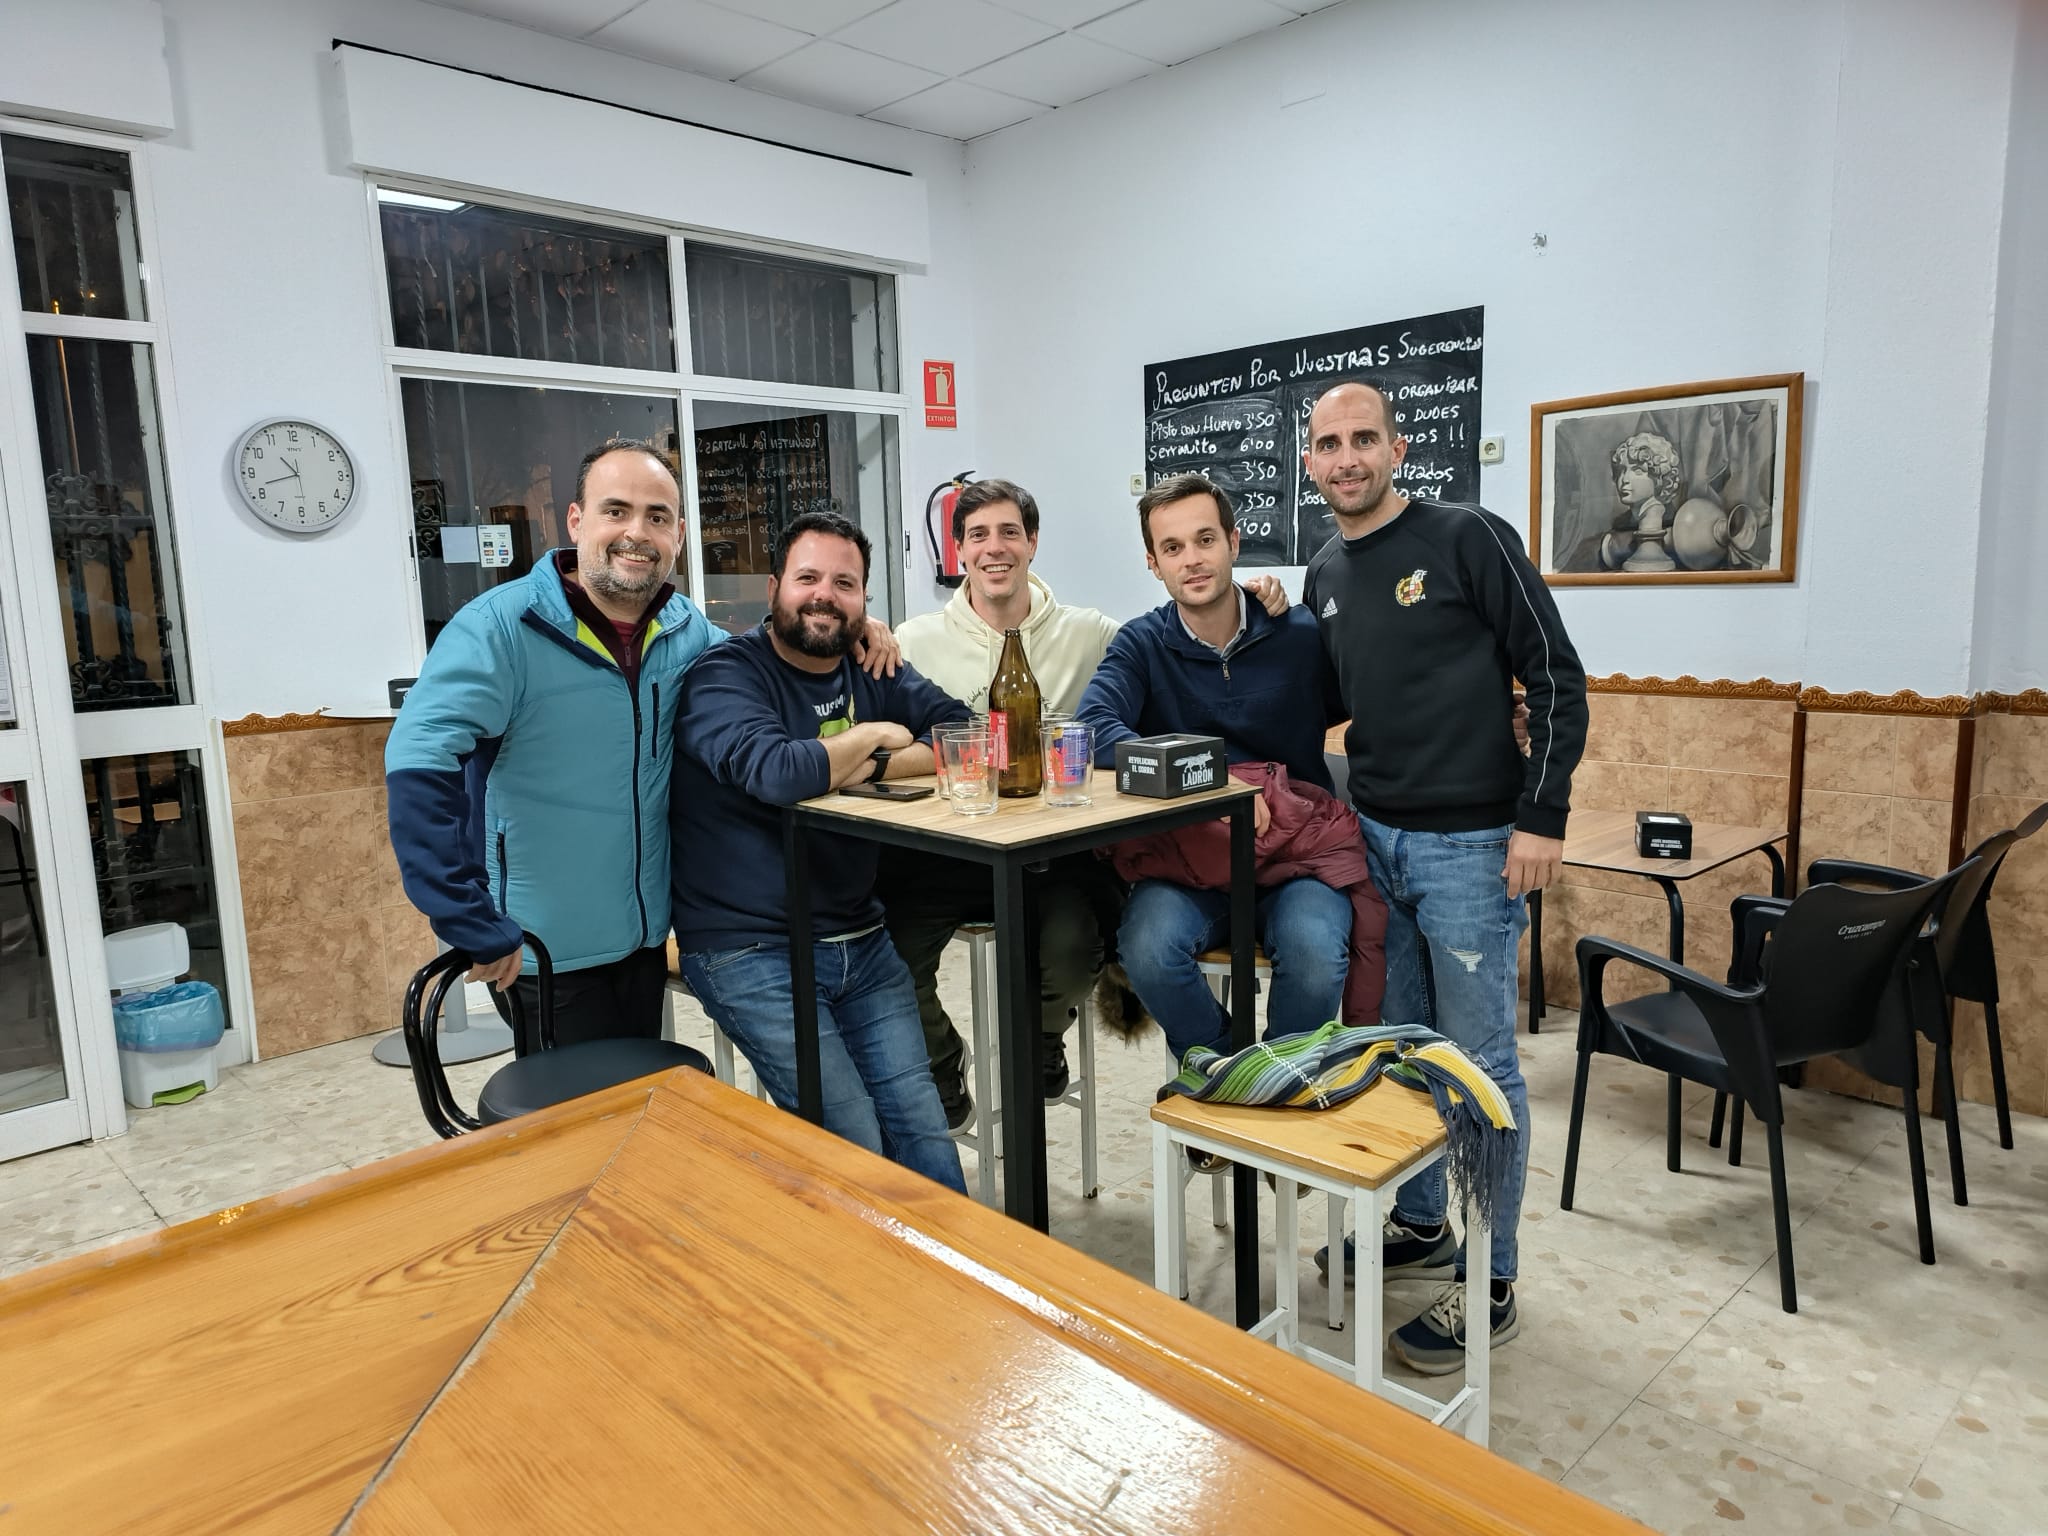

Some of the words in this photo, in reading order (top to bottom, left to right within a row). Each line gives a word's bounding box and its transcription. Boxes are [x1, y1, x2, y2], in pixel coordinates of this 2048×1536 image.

[1413, 405, 1460, 422] DUDES
[1151, 419, 1177, 441] Pisto
[1203, 415, 1241, 432] Huevo
[1243, 412, 1275, 430] 3'50
[266, 434, 276, 446] 11
[287, 430, 298, 442] 12
[311, 436, 316, 448] 1
[252, 447, 263, 459] 10
[1148, 437, 1217, 461] Serranito
[1240, 438, 1274, 452] 6'00
[328, 450, 335, 461] 2
[247, 467, 255, 479] 9
[337, 470, 344, 482] 3
[1242, 460, 1276, 481] 3'50
[258, 488, 266, 499] 8
[333, 488, 340, 499] 4
[278, 501, 285, 512] 7
[318, 502, 326, 513] 5
[1244, 491, 1275, 512] 3'50
[298, 506, 306, 517] 6
[1182, 766, 1214, 787] LADRÓN
